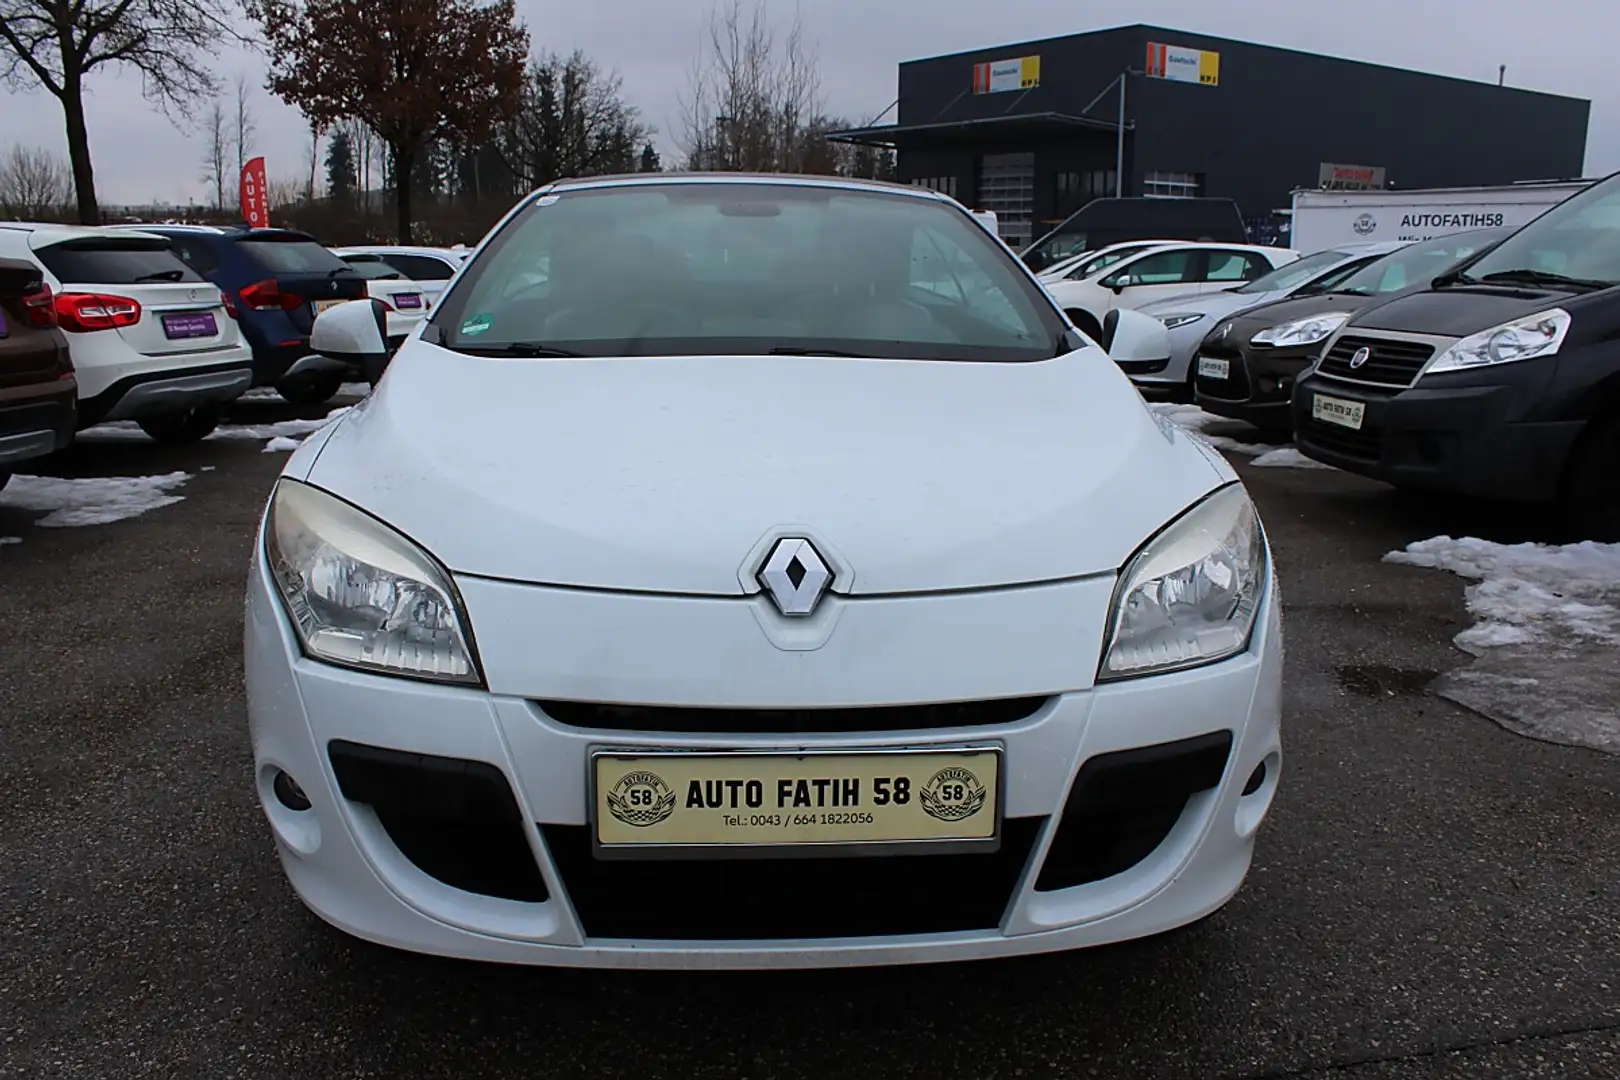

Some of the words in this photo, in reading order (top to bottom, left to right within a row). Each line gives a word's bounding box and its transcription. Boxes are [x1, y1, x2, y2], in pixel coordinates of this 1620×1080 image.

[244, 171, 258, 222] AUTO
[1401, 214, 1503, 227] AUTOFATIH58
[630, 789, 652, 805] 58
[686, 780, 763, 808] AUTO
[777, 778, 860, 808] FATIH
[873, 777, 911, 806] 58
[942, 784, 964, 800] 58
[722, 815, 748, 826] Tel.:
[750, 815, 781, 826] 0043
[793, 813, 817, 825] 664
[821, 812, 874, 825] 1822056
